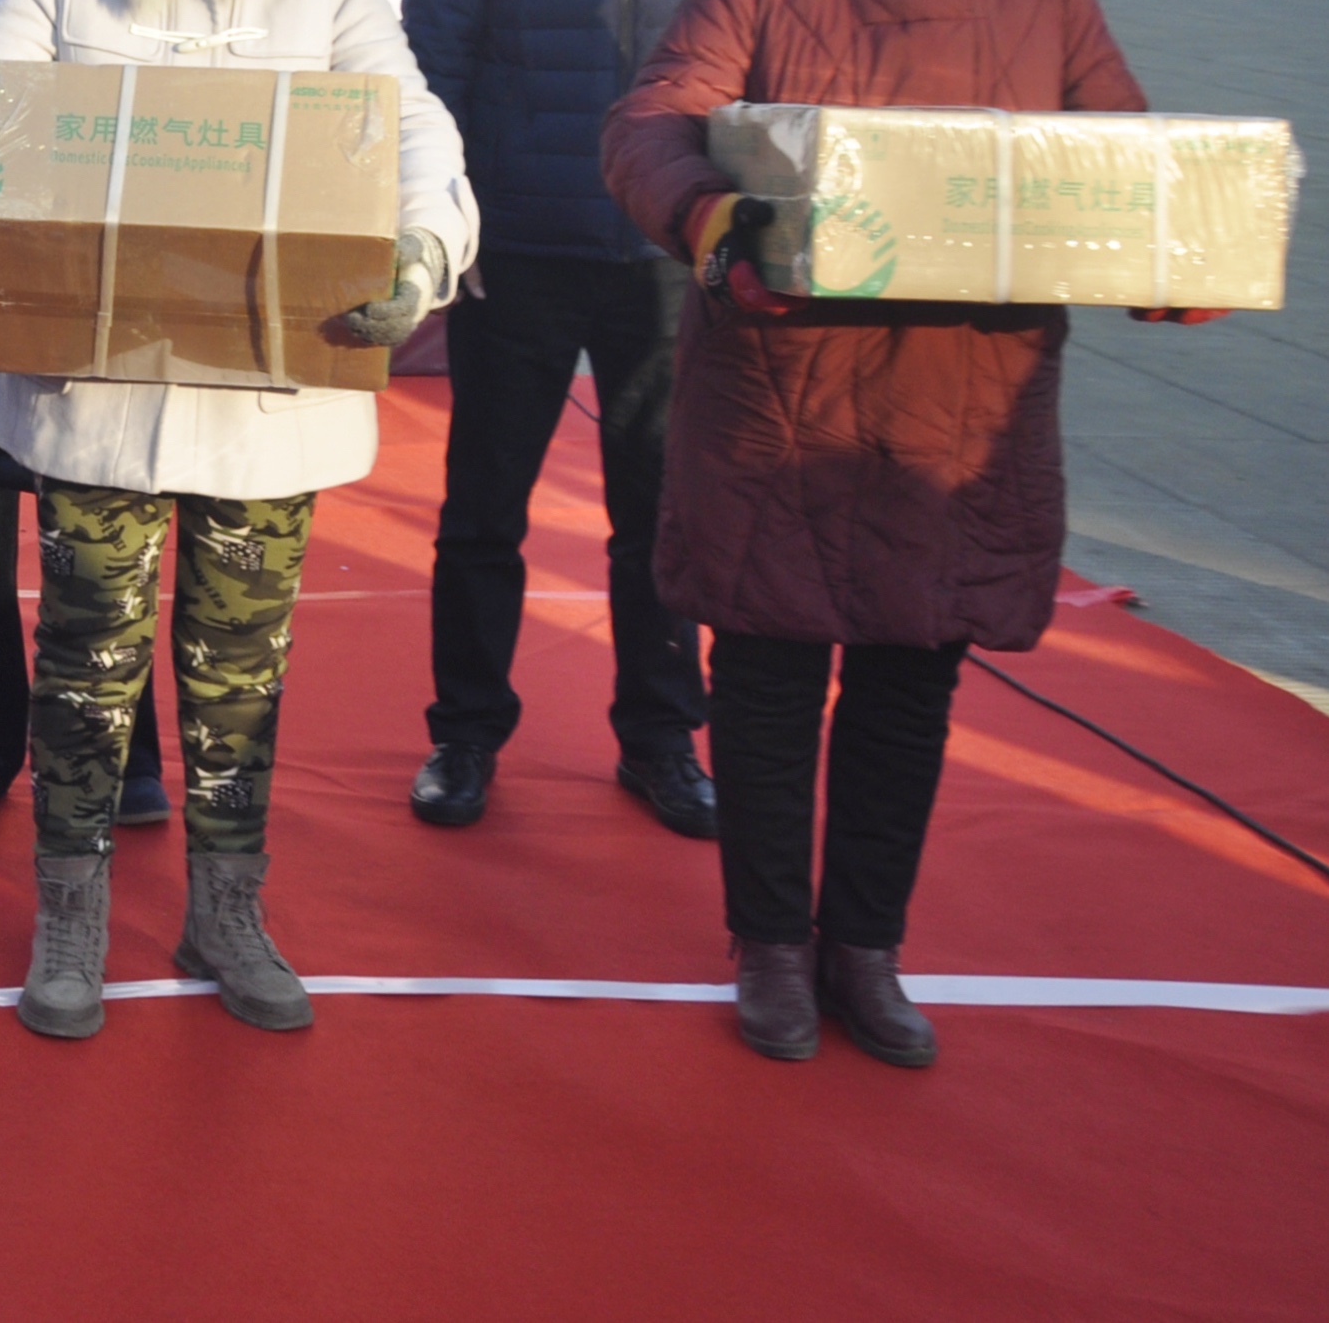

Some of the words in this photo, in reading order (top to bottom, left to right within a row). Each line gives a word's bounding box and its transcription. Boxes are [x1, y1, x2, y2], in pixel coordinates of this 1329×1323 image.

[55, 113, 267, 150] 家用燃气灶具
